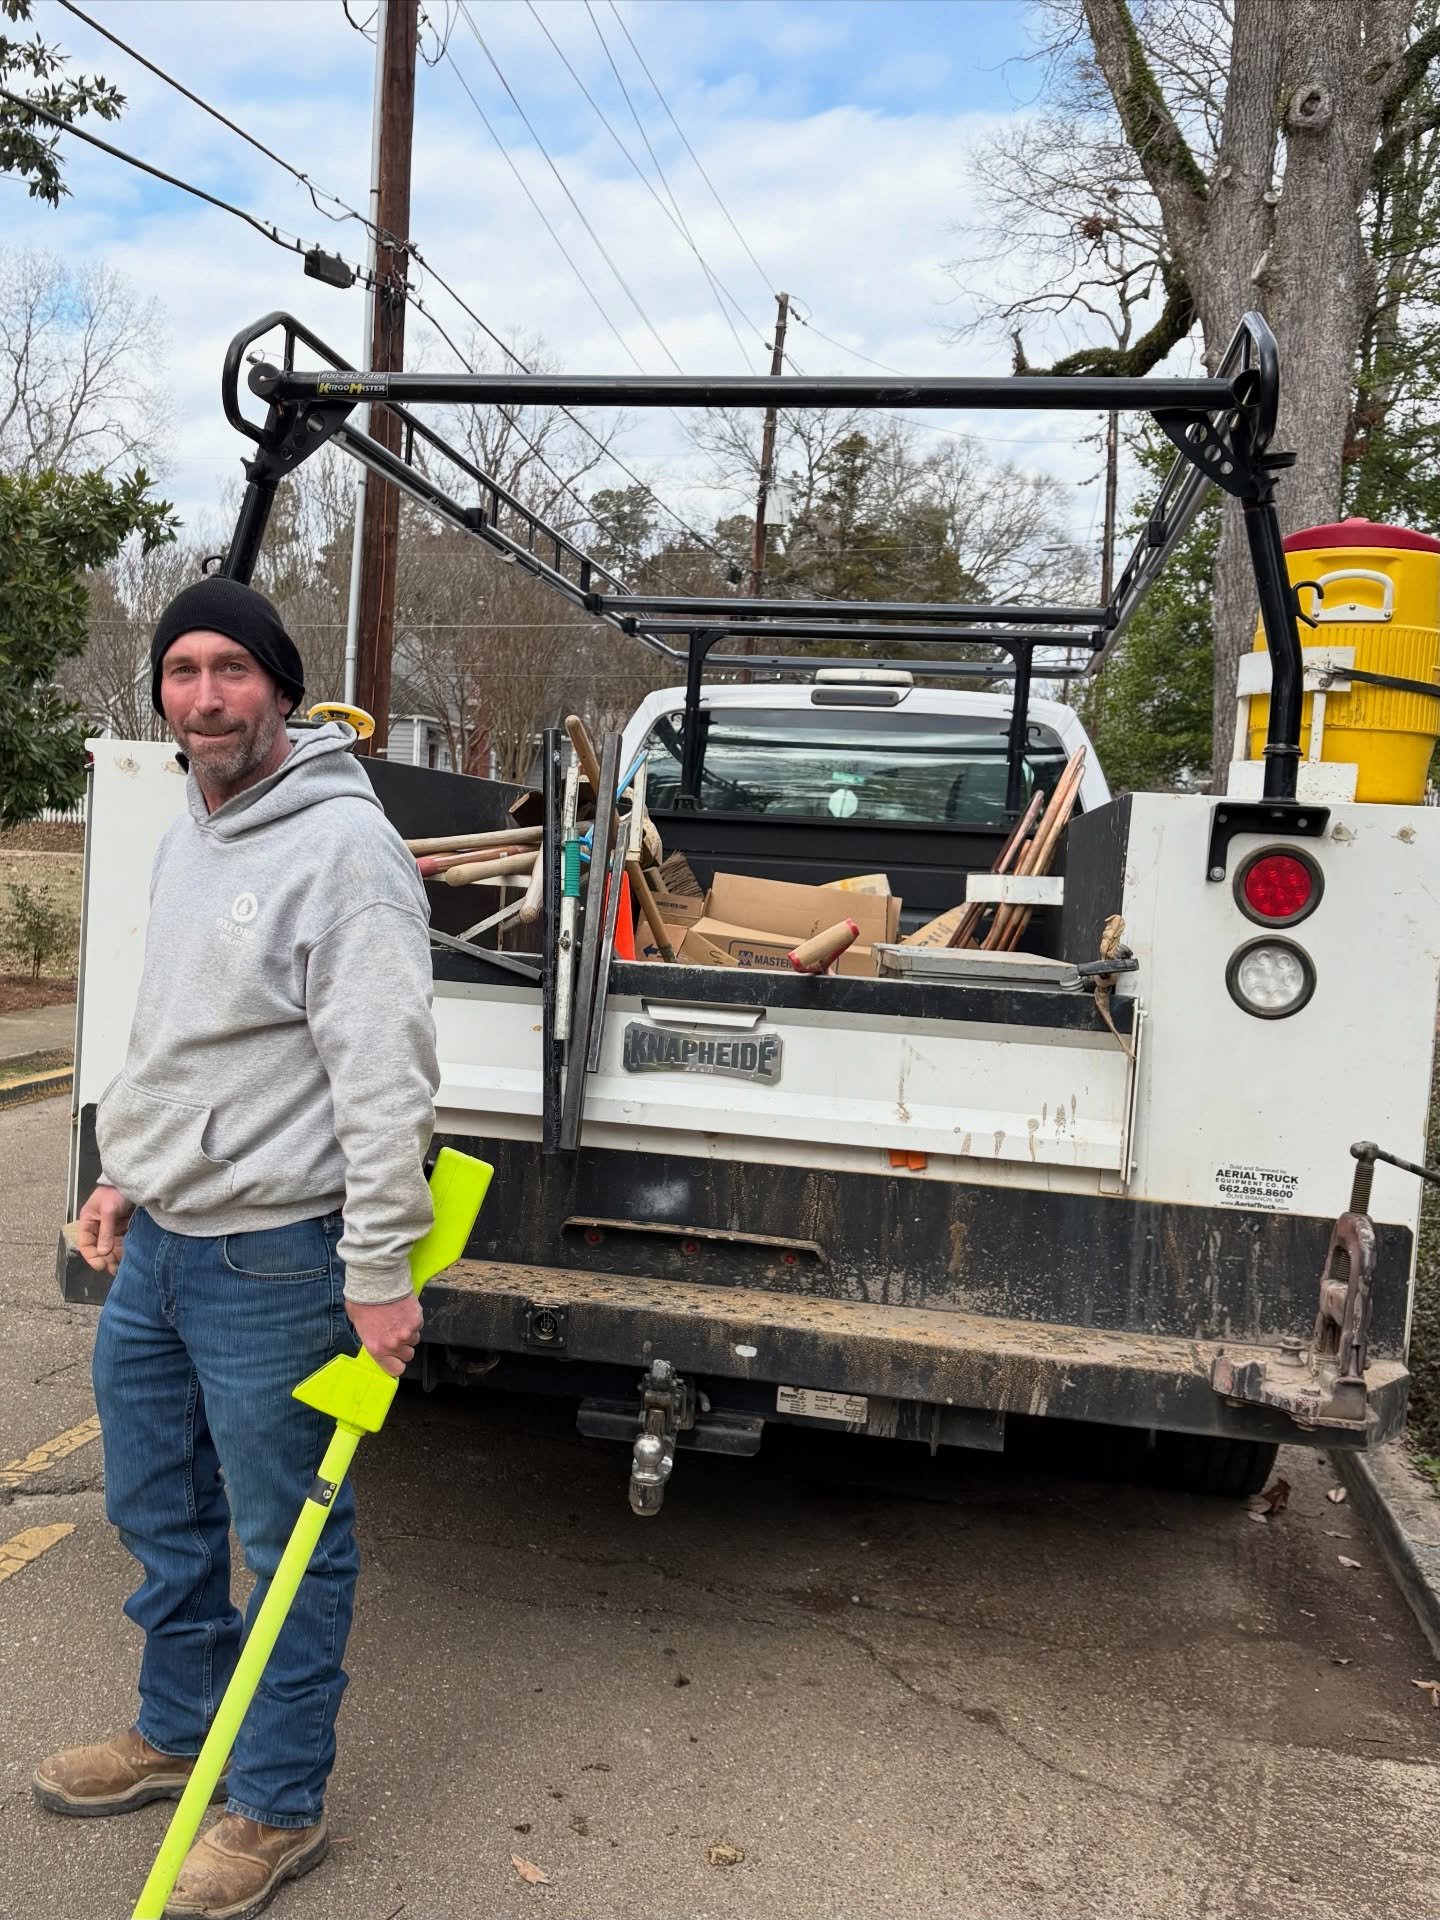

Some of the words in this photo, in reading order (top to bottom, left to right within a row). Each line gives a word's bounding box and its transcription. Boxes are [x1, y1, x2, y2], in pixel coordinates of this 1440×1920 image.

[630, 1029, 778, 1077] KNAPHEIDE
[1215, 1177, 1263, 1187] EQUIPMENT
[1216, 1169, 1257, 1180] AERIAL
[1260, 1173, 1299, 1184] TRUCK
[1219, 1184, 1293, 1199] 662.895.8600
